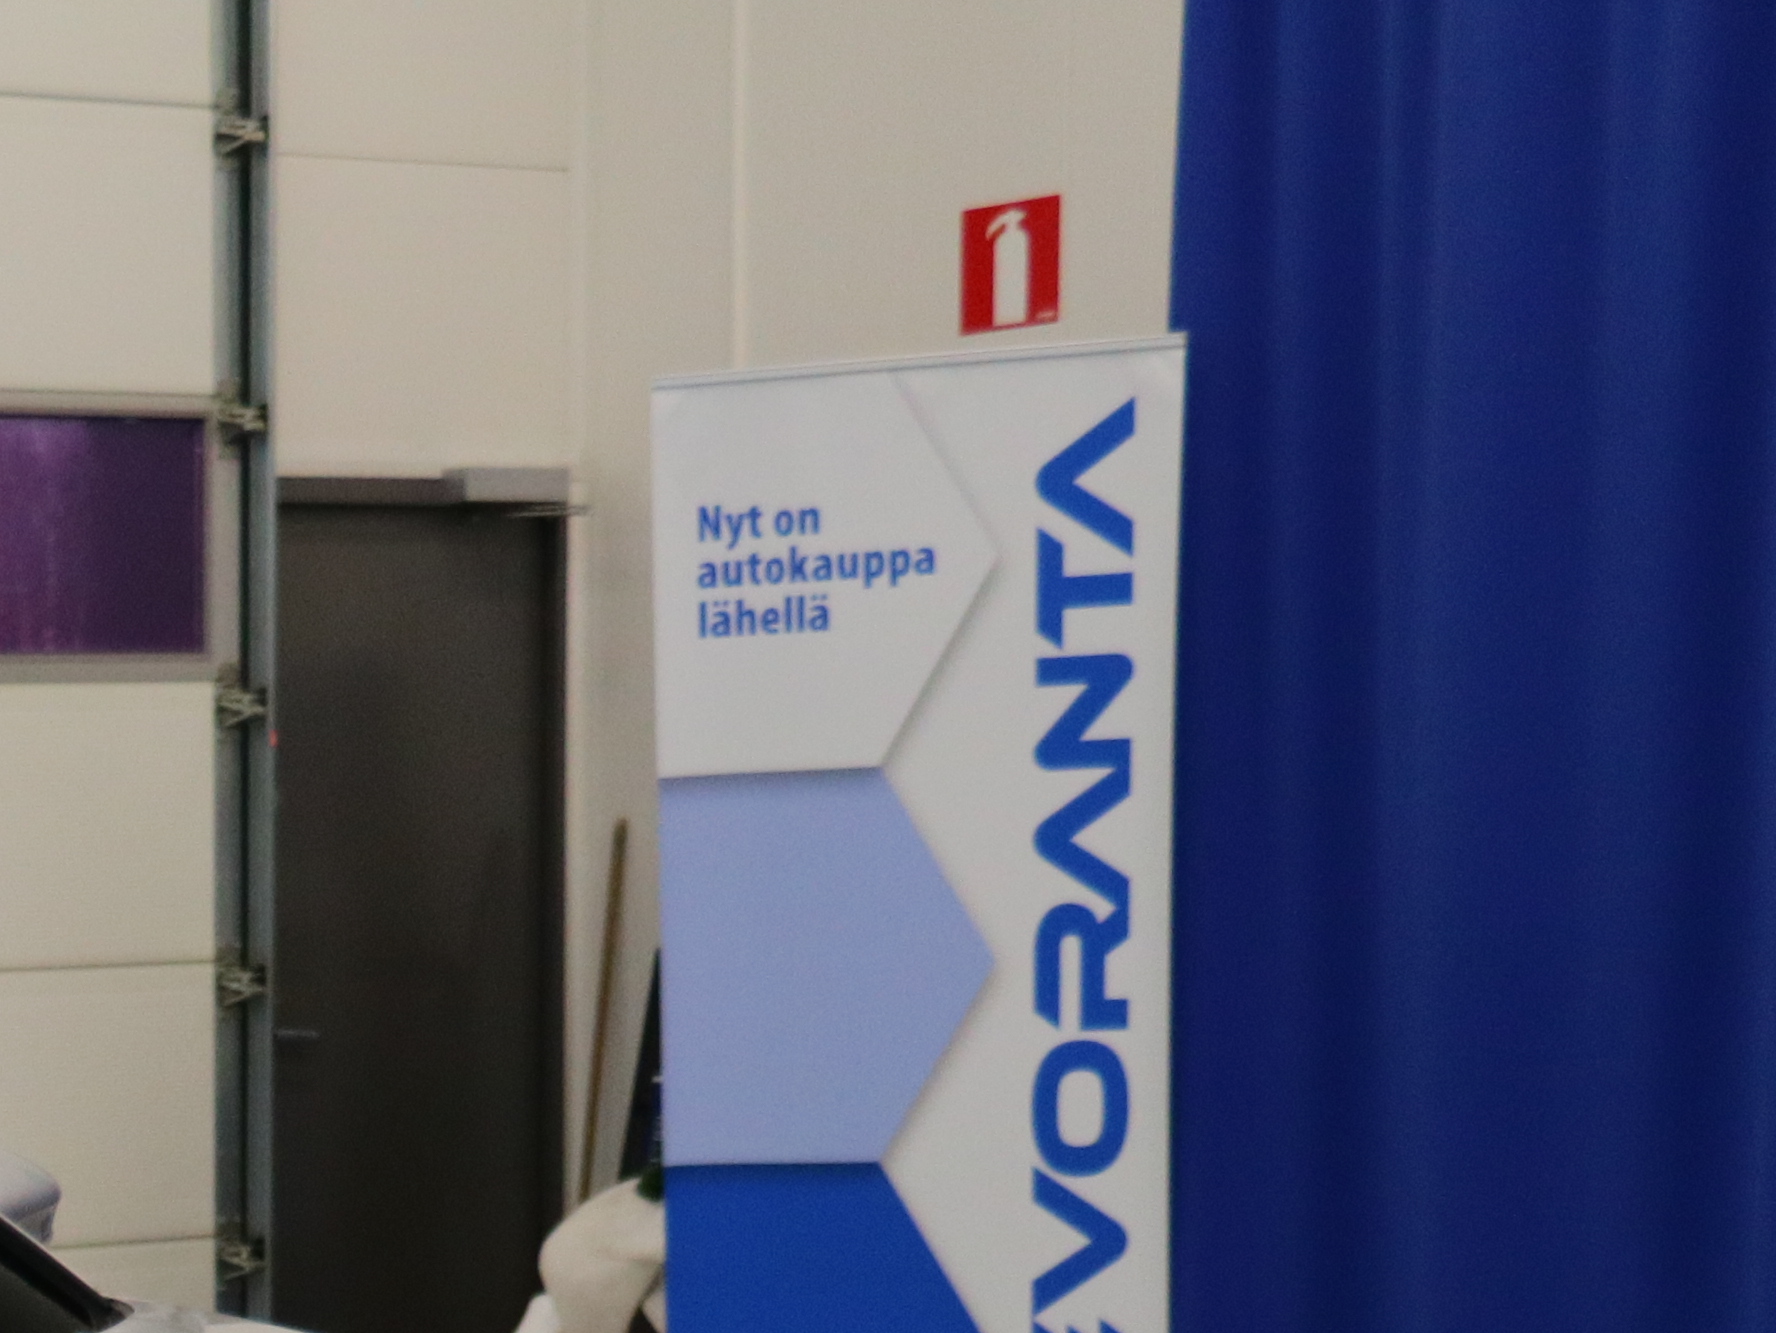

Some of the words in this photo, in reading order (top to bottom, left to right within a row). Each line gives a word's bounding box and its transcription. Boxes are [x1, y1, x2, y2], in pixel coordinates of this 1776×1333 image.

[698, 504, 761, 549] Nyt
[775, 506, 821, 535] on
[698, 547, 936, 588] autokauppa
[699, 595, 831, 639] lähellä
